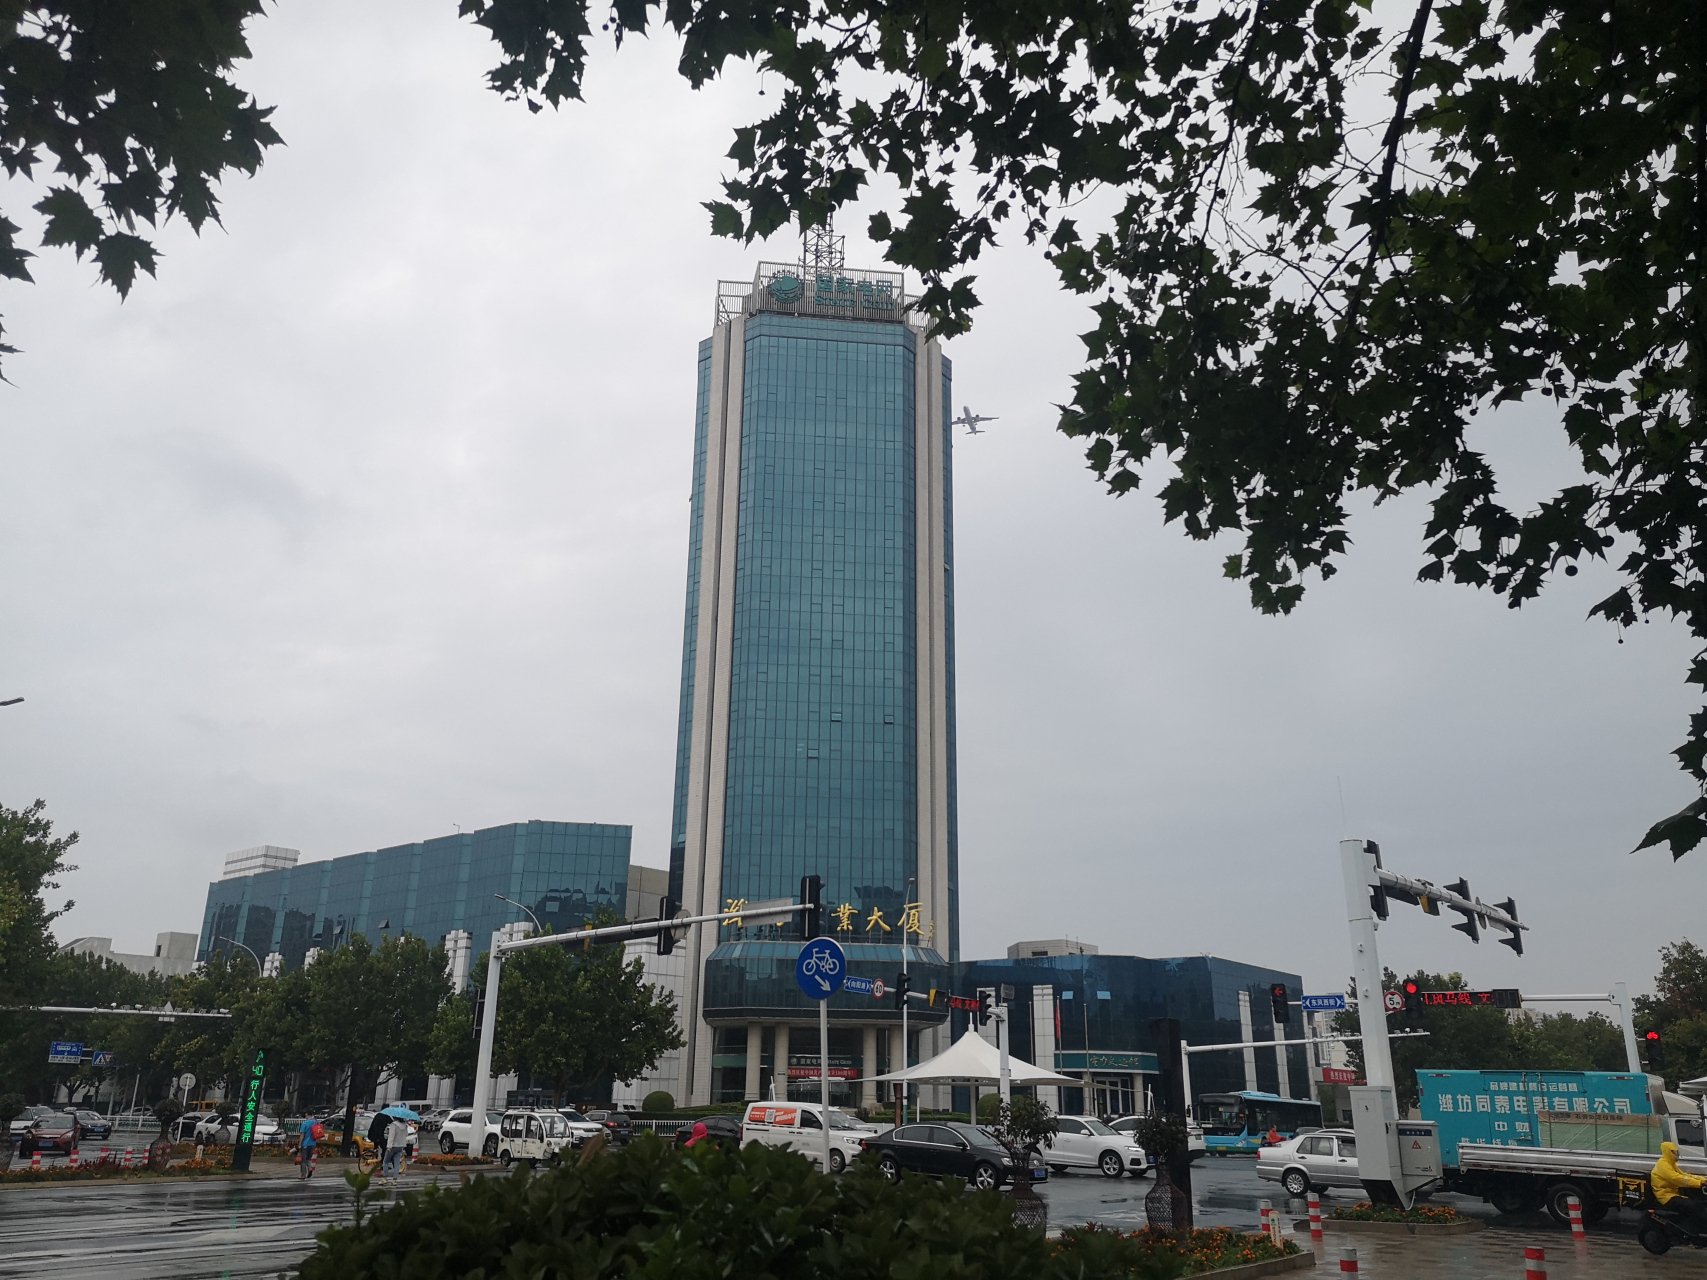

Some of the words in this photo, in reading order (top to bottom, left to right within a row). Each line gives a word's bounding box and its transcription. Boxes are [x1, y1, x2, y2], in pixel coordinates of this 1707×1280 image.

[816, 276, 893, 297] 国家电网
[875, 984, 883, 994] 60
[1310, 998, 1337, 1008] 东风西街
[252, 1065, 264, 1076] 40
[241, 1079, 260, 1144] 行人安全通行
[1437, 1093, 1632, 1116] 潍坊同泰电器有限公司
